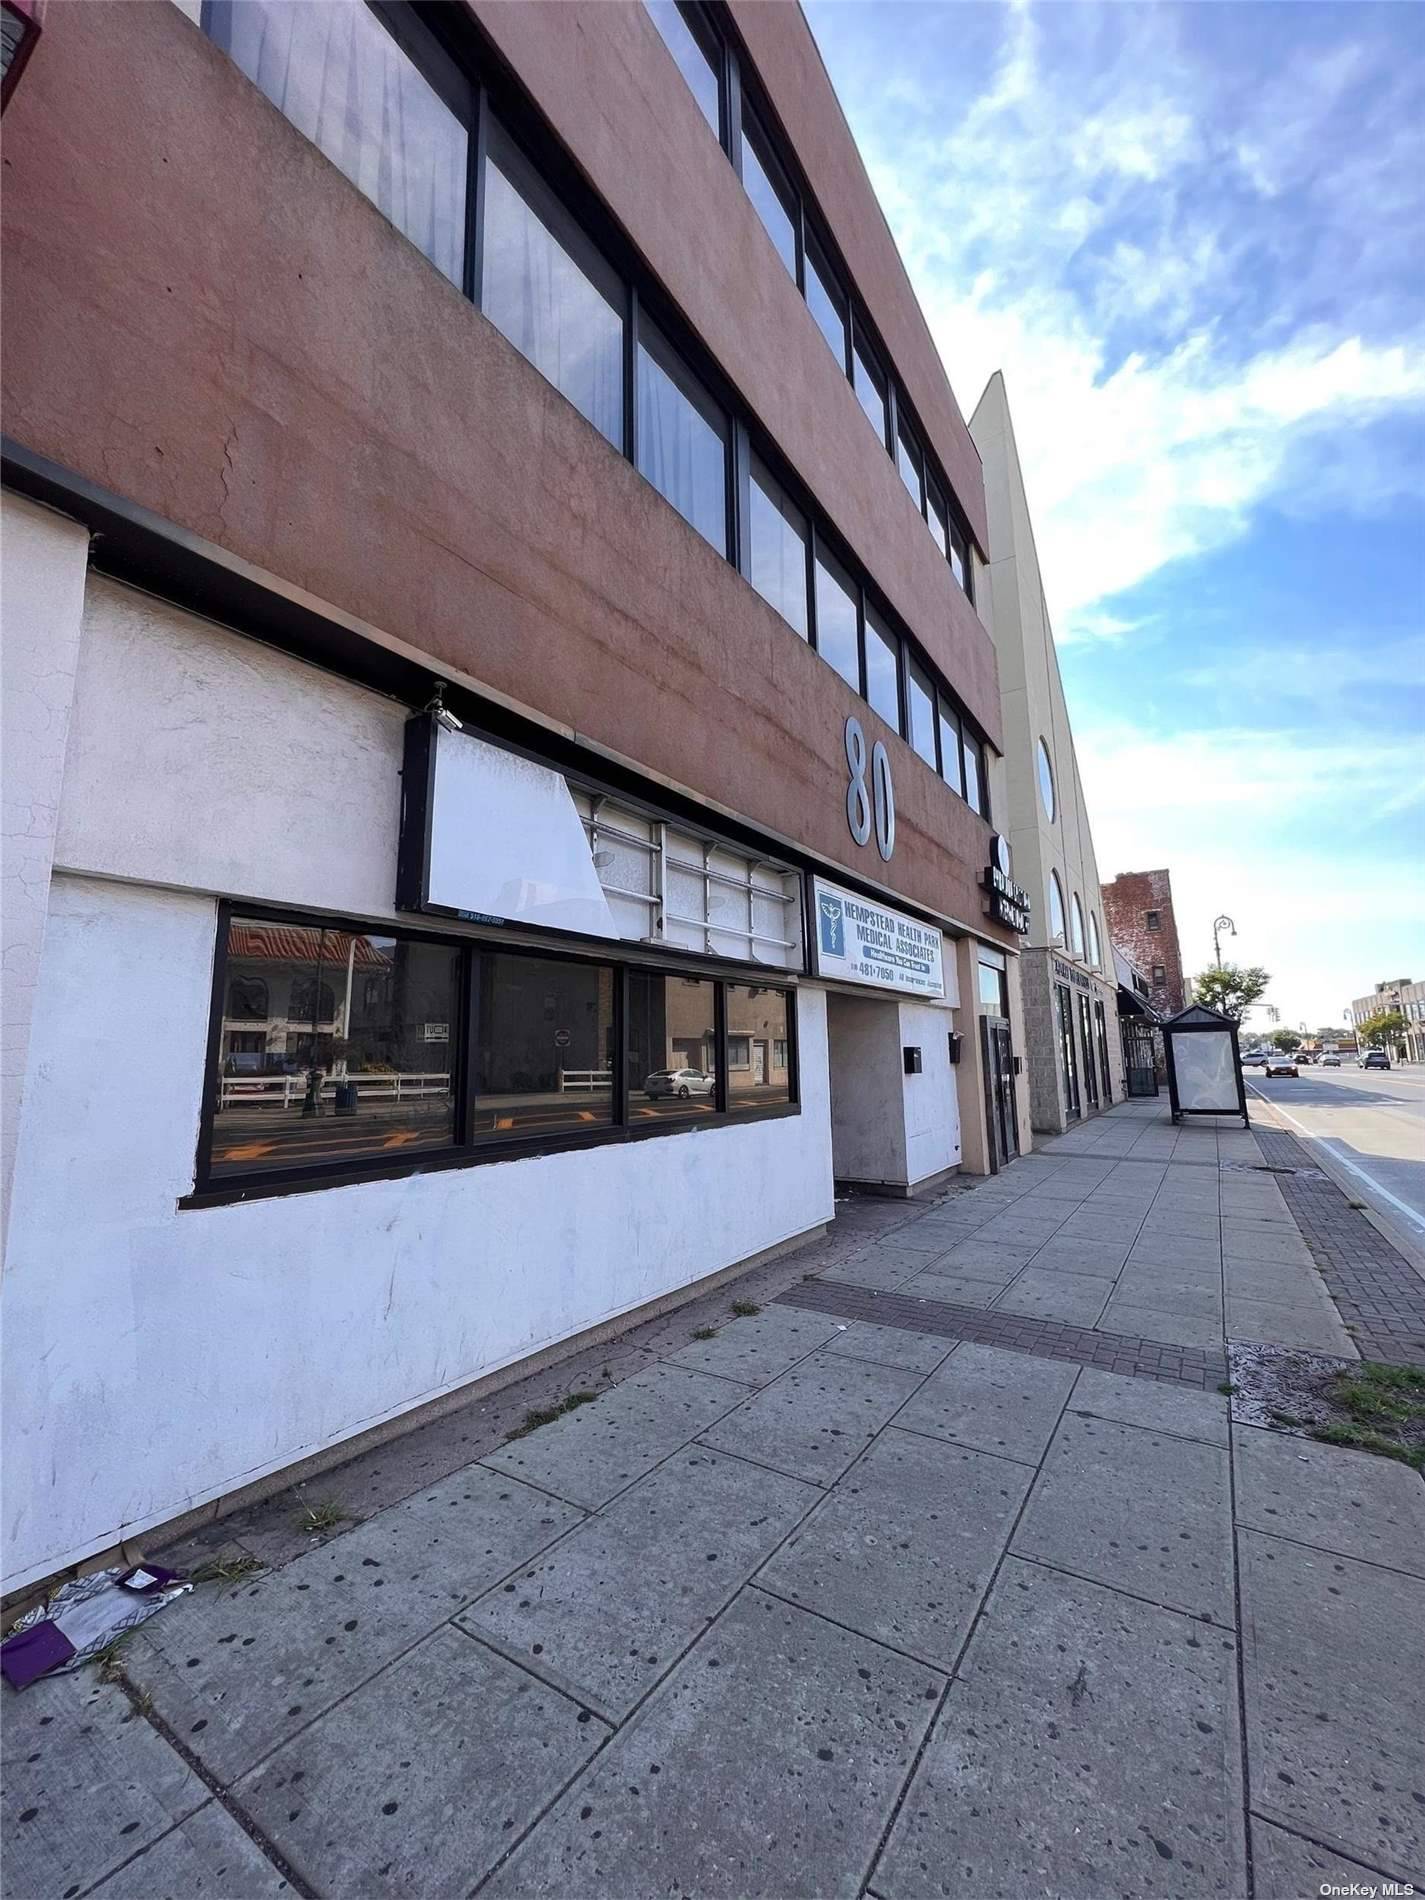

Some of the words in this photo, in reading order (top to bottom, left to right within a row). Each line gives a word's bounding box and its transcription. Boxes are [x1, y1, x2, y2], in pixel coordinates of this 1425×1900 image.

[845, 716, 895, 862] 80
[844, 901, 894, 933] HEMPSTEAD
[897, 921, 922, 944] HEALTH
[924, 933, 939, 950] PARK
[856, 924, 893, 950] MEDICAL
[896, 938, 935, 962] ASSOCIATES
